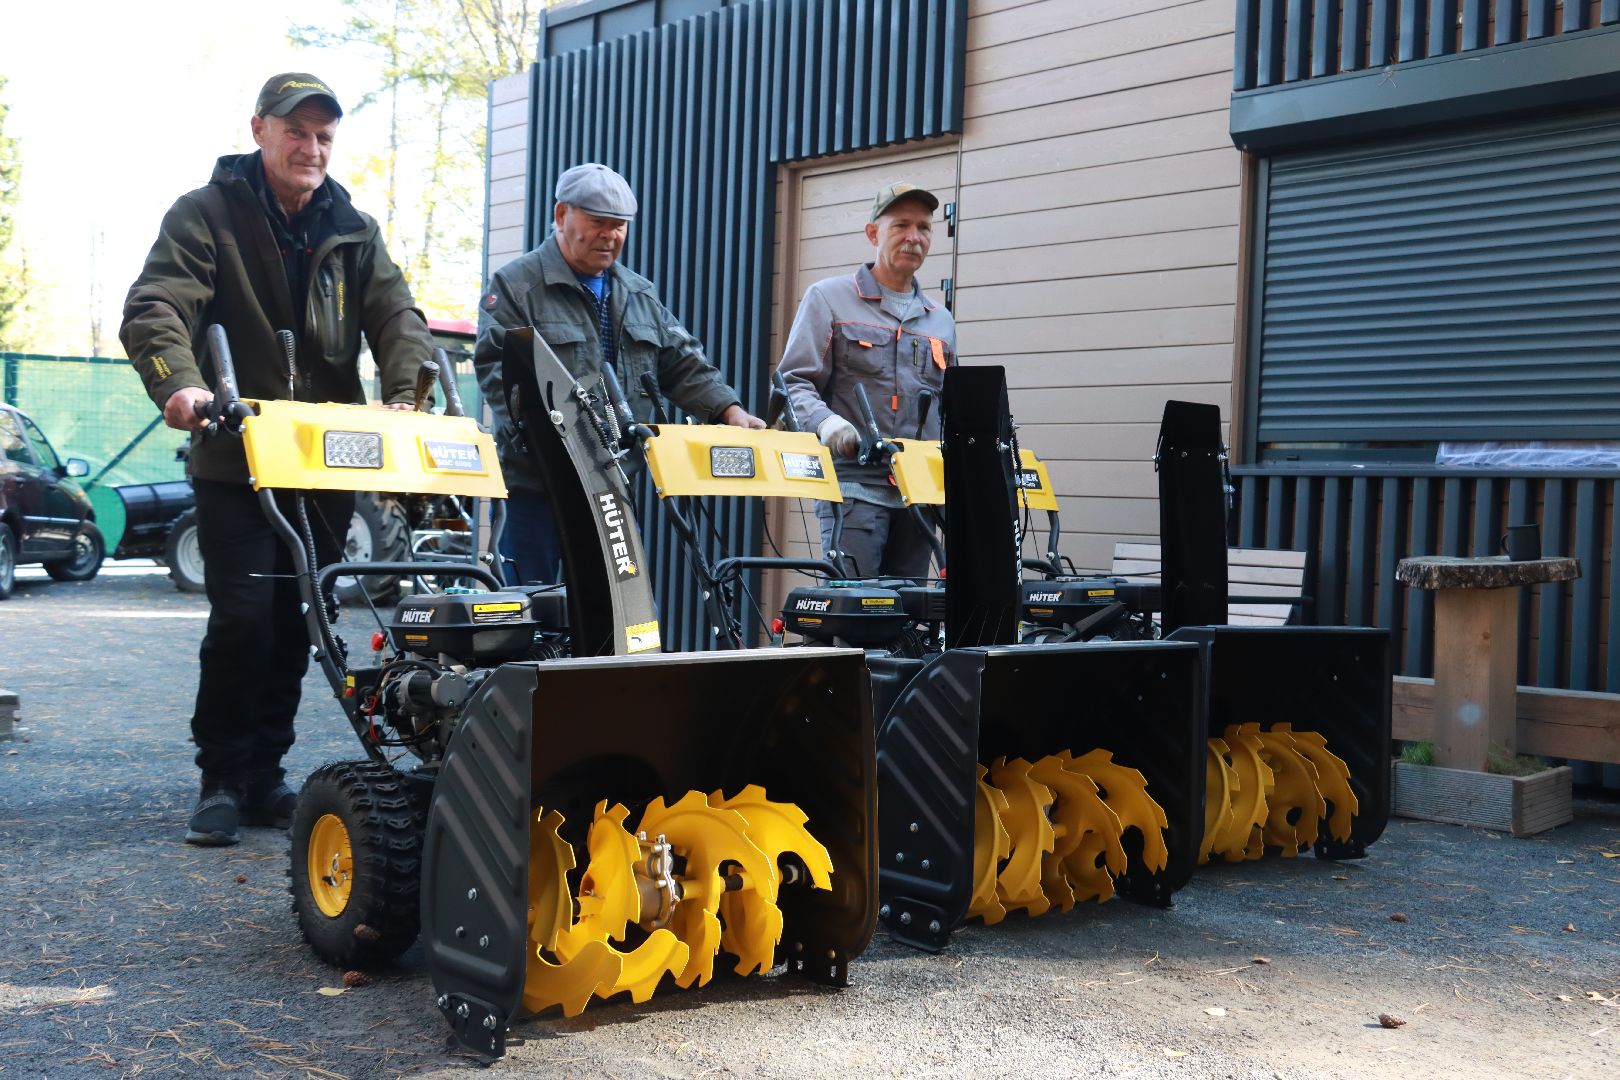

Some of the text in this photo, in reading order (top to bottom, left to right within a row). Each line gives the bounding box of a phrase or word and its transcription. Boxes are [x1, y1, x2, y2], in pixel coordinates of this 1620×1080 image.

[599, 493, 631, 575] HÜTER
[1029, 591, 1061, 602] HÜTER
[795, 598, 829, 612] HÜTER
[401, 608, 432, 623] HÜTER
